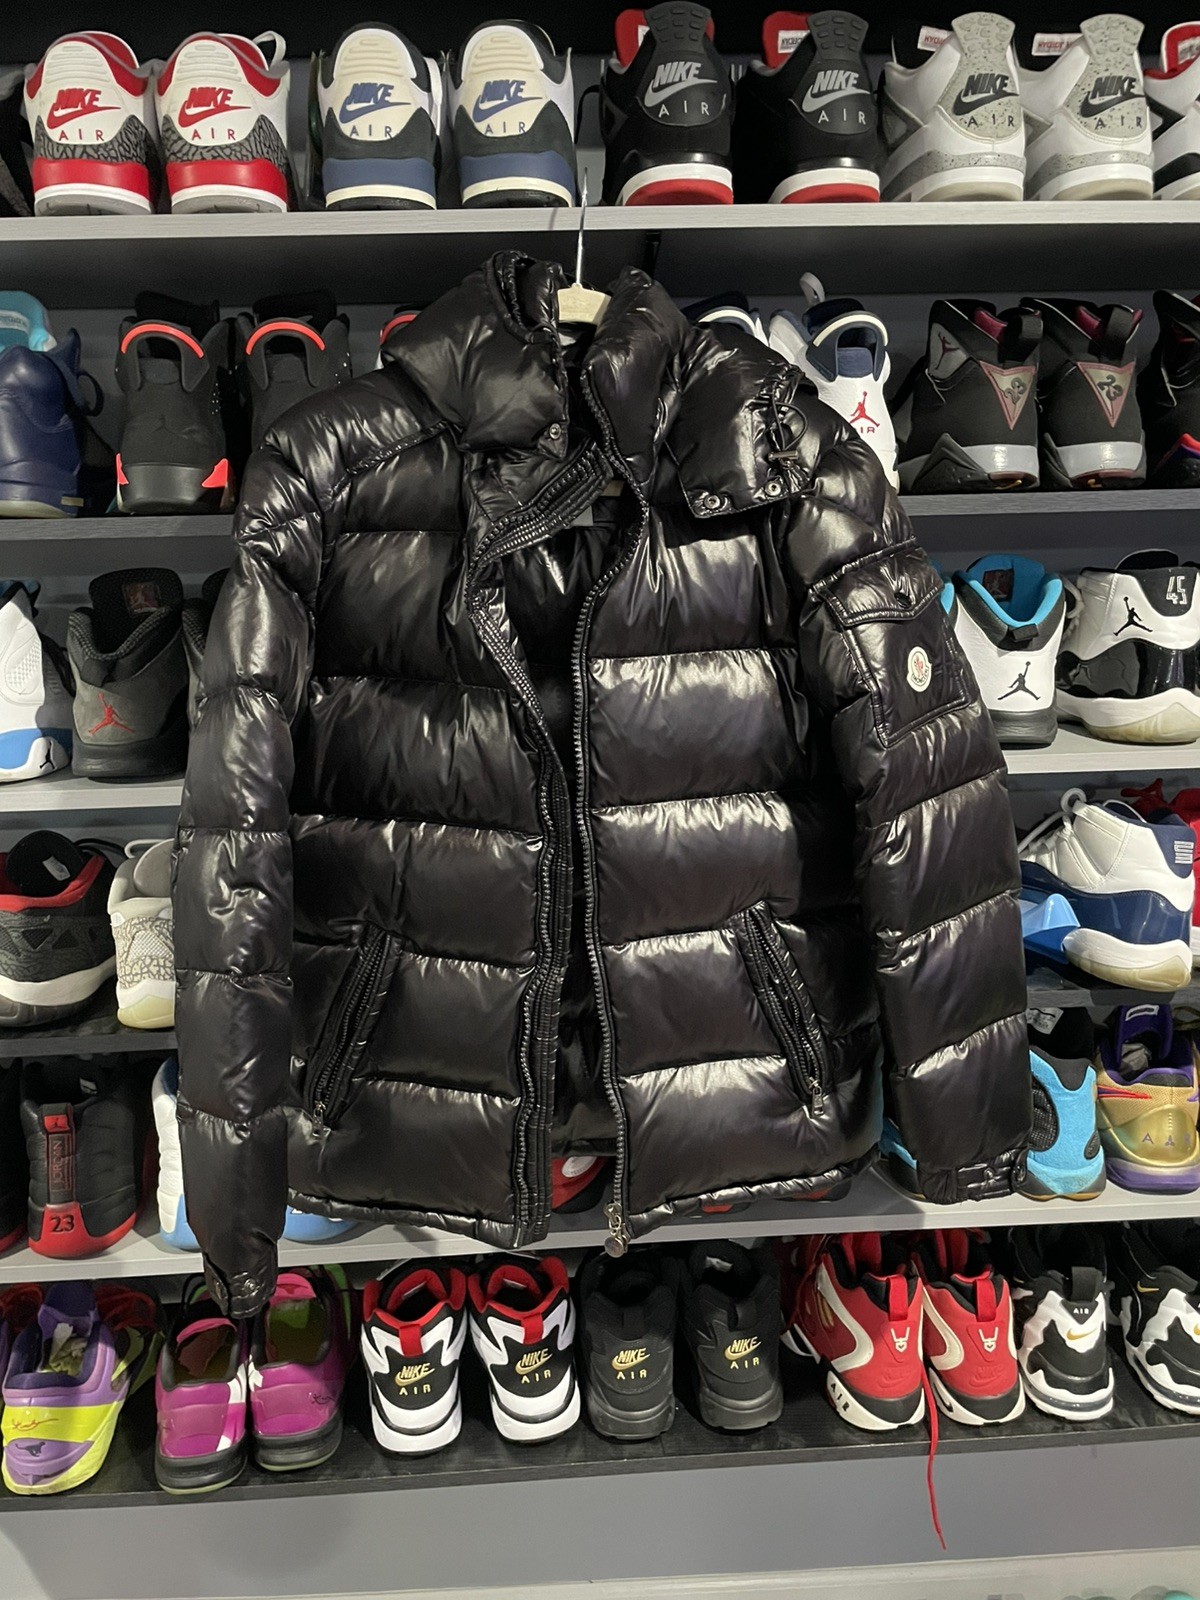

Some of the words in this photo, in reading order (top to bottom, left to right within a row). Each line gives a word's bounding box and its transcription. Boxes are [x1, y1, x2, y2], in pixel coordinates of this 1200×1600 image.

[652, 61, 702, 88] NIKE
[812, 70, 859, 94] NIKE
[349, 83, 394, 105] NIKE
[480, 79, 526, 104] NIKE
[962, 73, 1009, 98] NIKE
[1090, 75, 1136, 100] NIKE
[55, 88, 101, 111] NIKE
[186, 87, 233, 109] NIKE
[658, 100, 710, 118] AIR
[817, 108, 866, 125] AIR
[484, 121, 526, 134] AIR
[966, 113, 1015, 128] AIR
[1095, 115, 1142, 131] AIR
[58, 128, 104, 141] AIR
[192, 127, 236, 141] AIR
[350, 124, 393, 139] AIR
[860, 426, 875, 434] IR
[1166, 575, 1187, 604] 45
[53, 1140, 64, 1184] JORDAN
[51, 1214, 75, 1232] 23
[1073, 1307, 1090, 1315] AIR
[730, 1336, 758, 1353] NIKE
[521, 1348, 549, 1367] NIKE
[617, 1347, 647, 1363] NIKE
[730, 1356, 760, 1370] AIR
[400, 1362, 431, 1380] NIKE
[521, 1369, 552, 1384] AIR
[616, 1369, 647, 1380] AIR
[399, 1384, 431, 1396] AIR
[831, 1383, 850, 1412] AIR
